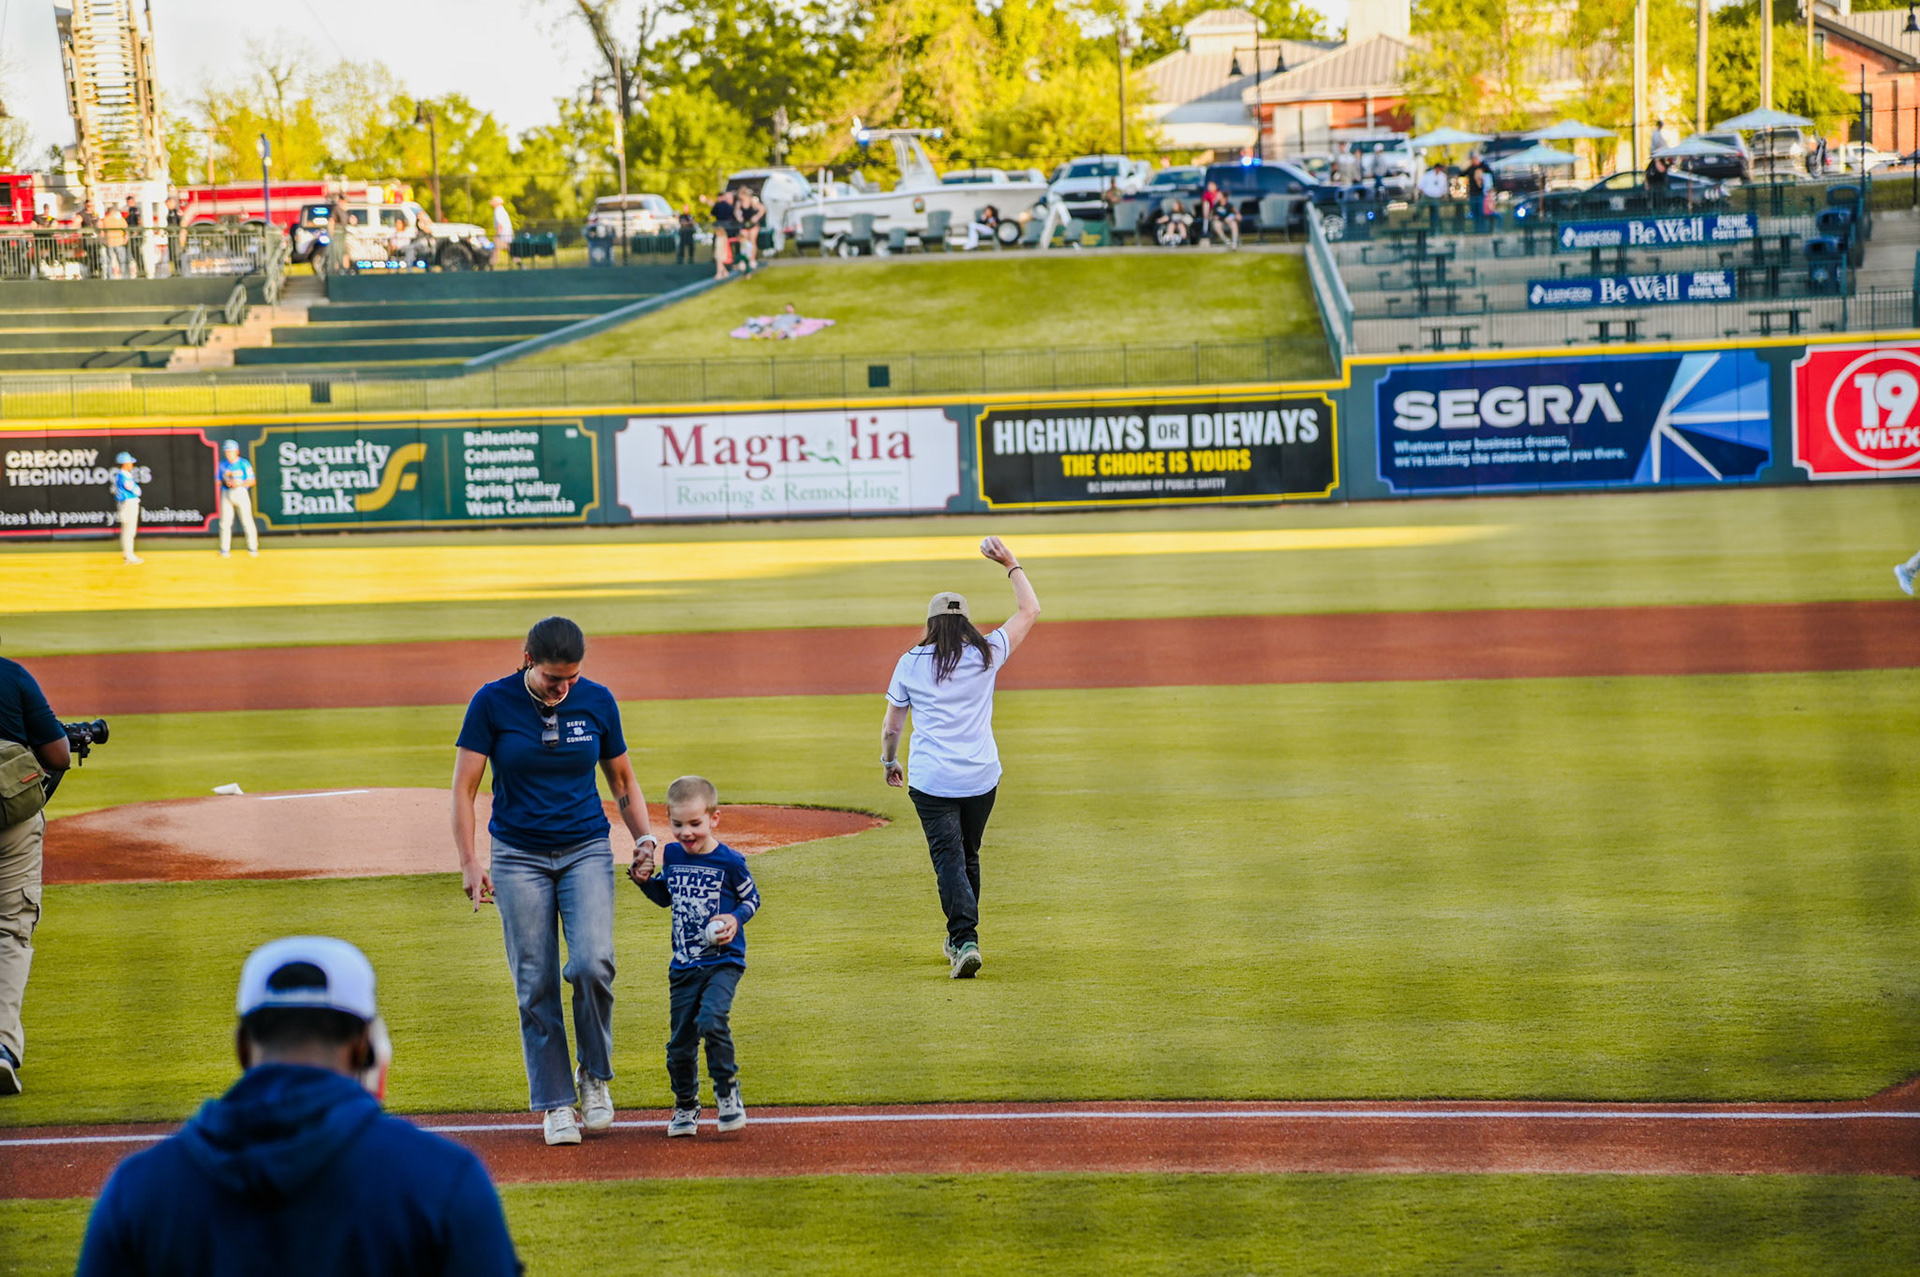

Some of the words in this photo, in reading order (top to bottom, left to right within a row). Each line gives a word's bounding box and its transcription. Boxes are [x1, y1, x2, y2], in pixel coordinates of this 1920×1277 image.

[1629, 220, 1656, 244] Be
[1656, 216, 1704, 243] Well
[1600, 277, 1628, 304] Be
[1628, 274, 1679, 301] Well
[1394, 382, 1623, 431] SEGRA
[1854, 369, 1919, 428] 19
[463, 429, 539, 446] Ballentine
[993, 415, 1145, 455] HIGHWAYS
[1158, 421, 1180, 440] OR
[1192, 408, 1319, 447] DIEWAYS
[1855, 426, 1920, 450] WLTX
[279, 439, 391, 469] Security
[658, 416, 914, 481] Magnlia
[1394, 440, 1446, 454] Whatever
[1449, 441, 1472, 454] your
[1474, 437, 1523, 451] business
[1524, 435, 1571, 448] dreams,
[6, 449, 99, 469] GREGORY
[464, 447, 534, 464] Columbia
[1061, 454, 1096, 477] THE
[1098, 451, 1165, 476] CHOICE
[1168, 450, 1188, 474] IS
[1190, 448, 1251, 472] YOURS
[1426, 453, 1470, 468] building
[1472, 451, 1490, 465] the
[1492, 450, 1535, 464] network
[1538, 450, 1550, 463] to
[1552, 449, 1571, 463] get
[1572, 449, 1593, 463] you
[1594, 446, 1627, 460] there.
[6, 465, 152, 486] TECHNOLOGES
[281, 464, 380, 490] Federal
[465, 465, 539, 483] Lexington
[281, 488, 354, 515] Bank
[465, 482, 514, 501] Spring
[515, 481, 561, 499] Valley
[676, 484, 754, 507] Roofing
[760, 486, 776, 501] &
[784, 480, 899, 505] Remodeling
[29, 508, 58, 524] that
[59, 511, 105, 526] power
[141, 506, 204, 523] business.
[465, 500, 505, 516] West
[506, 497, 575, 515] Columbia
[566, 720, 586, 728] SERVE
[566, 735, 593, 743] CONNECT
[667, 871, 721, 889] STAR
[669, 884, 720, 899] WARS
